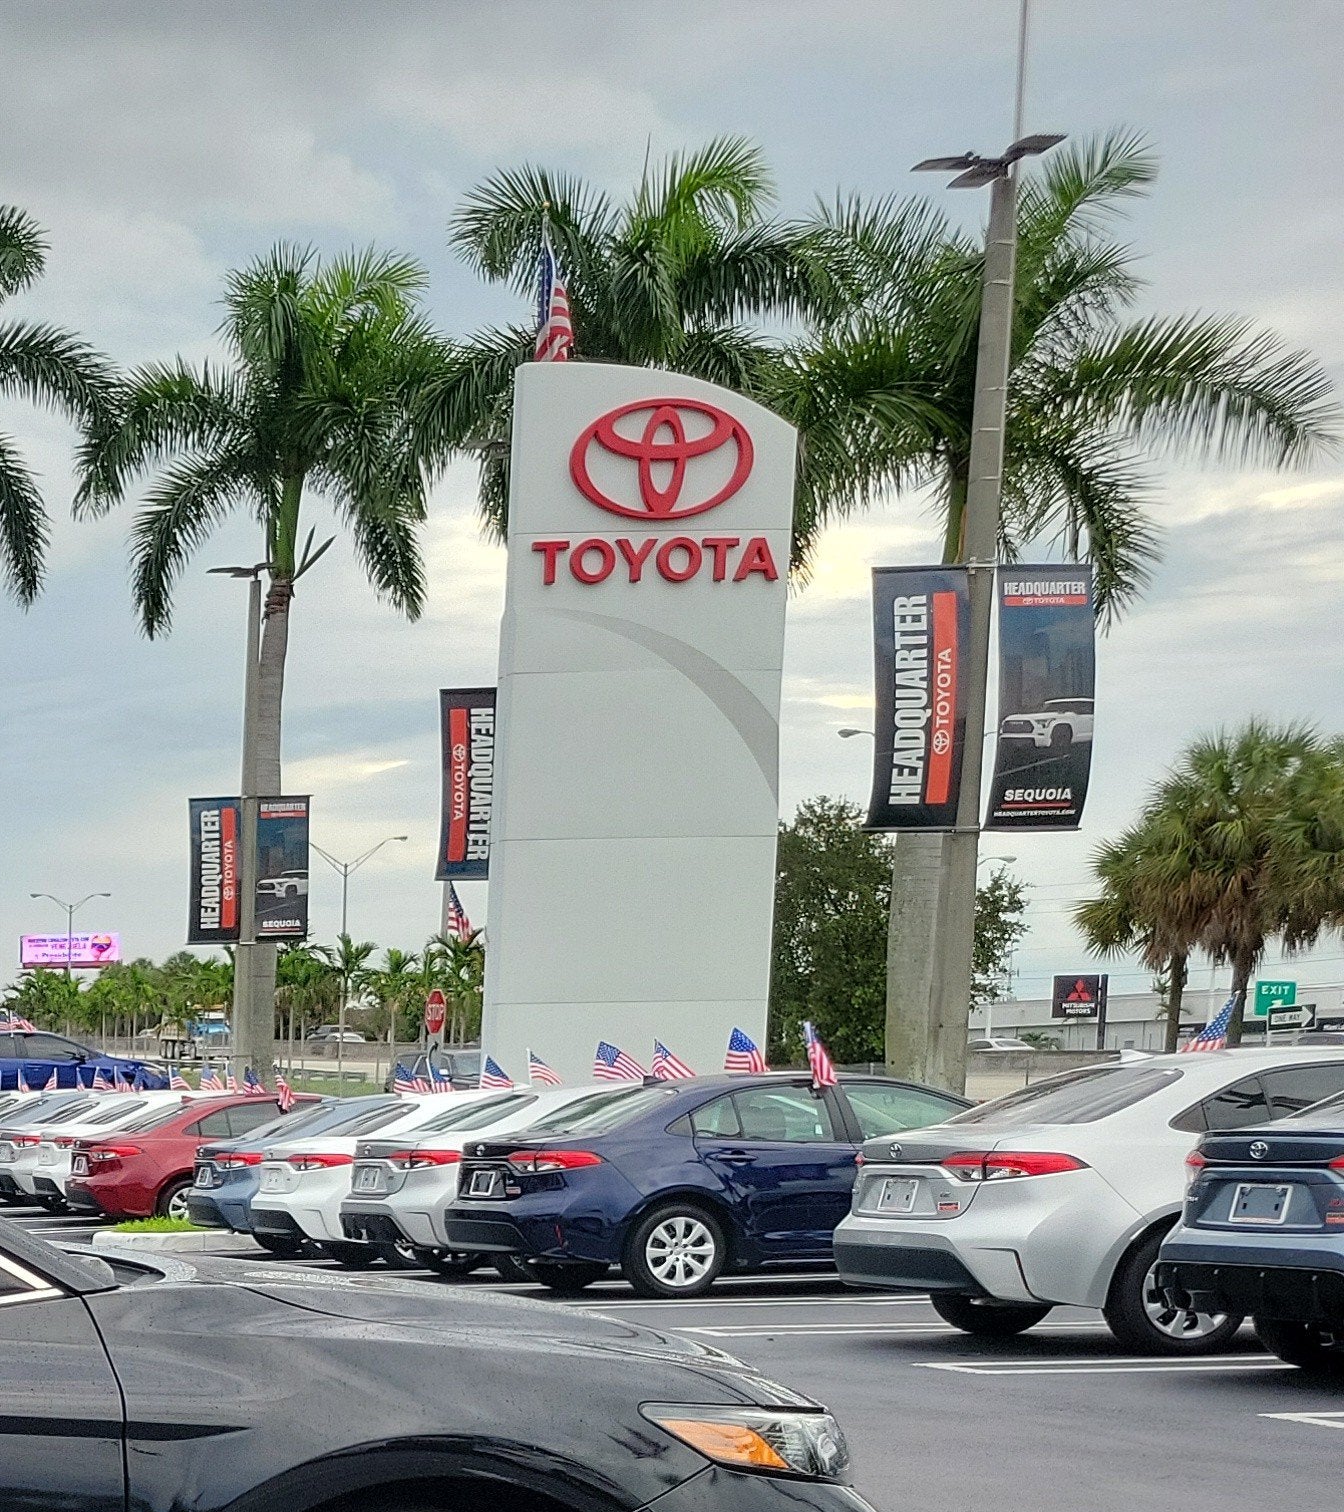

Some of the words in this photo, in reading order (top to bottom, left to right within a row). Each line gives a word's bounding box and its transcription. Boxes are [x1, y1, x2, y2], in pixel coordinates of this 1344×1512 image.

[532, 536, 779, 586] TOYOTA
[1003, 581, 1087, 597] HEADQUARTER
[1033, 597, 1065, 605] TOYOTA
[888, 595, 931, 805] HEADQUARTER
[936, 648, 952, 728] TOYOTA
[453, 765, 464, 820] TOYOTA
[467, 708, 494, 861] HEADQUARTER
[1004, 788, 1072, 802] SEQUOIA
[200, 810, 221, 929] HEADQUARTER
[224, 840, 234, 887] TOYOTA
[262, 919, 301, 928] SEQUOIA
[1262, 985, 1290, 995] EXIT
[427, 1003, 443, 1020] STOP
[1274, 1014, 1288, 1023] ONE
[1289, 1012, 1301, 1022] WAY
